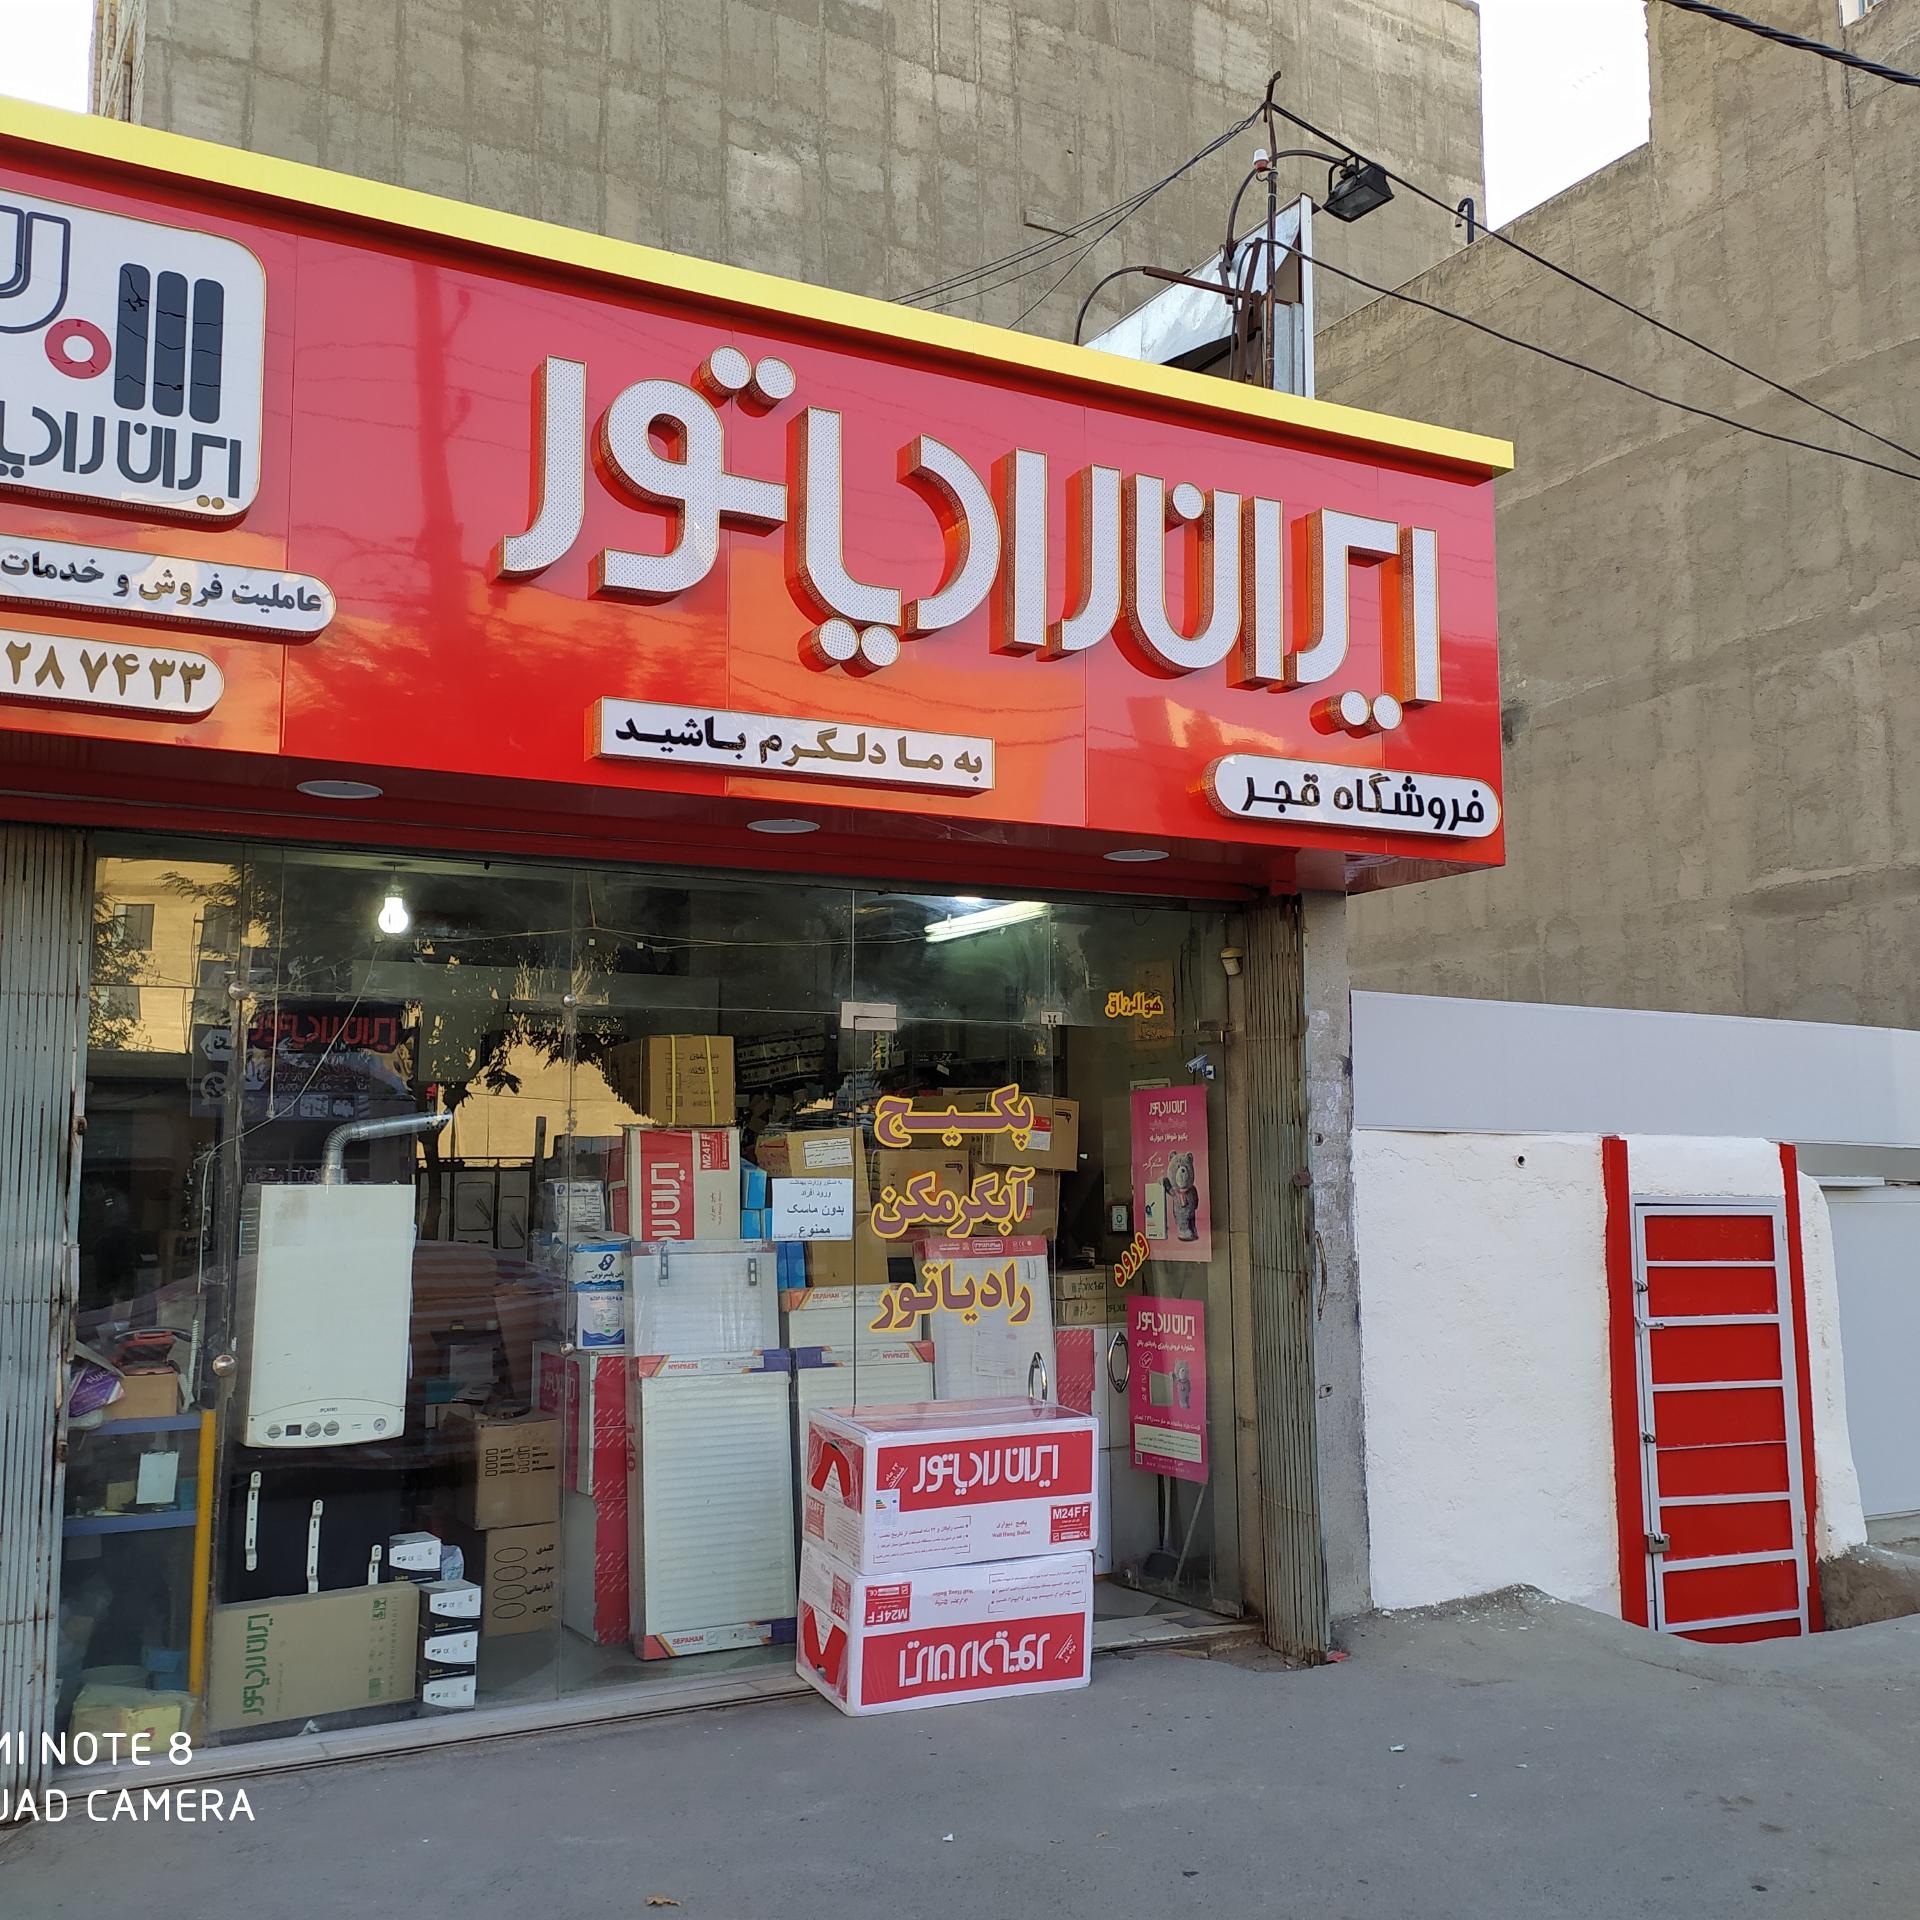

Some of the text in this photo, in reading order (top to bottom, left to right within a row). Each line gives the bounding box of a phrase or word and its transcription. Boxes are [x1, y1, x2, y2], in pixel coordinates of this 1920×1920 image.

[117, 419, 242, 510] ایران
[496, 343, 1439, 731] ایران رادیاتور
[0, 551, 323, 614] عاملیت فروش و خدمات
[615, 715, 983, 783] به ما دلگرم باشید
[1241, 773, 1485, 831] فروشگاه قجر
[875, 1084, 1034, 1151] پکیج
[1149, 1099, 1187, 1117] ایران رادیاتور
[651, 1162, 686, 1216] ایران
[786, 1204, 845, 1216] بدون ماسک
[800, 1188, 831, 1198] ورود افراد
[871, 1167, 1035, 1238] آبگرمکن
[798, 1223, 831, 1239] ممنوع
[1114, 1232, 1149, 1287] ورود
[870, 1259, 1032, 1333] رادیاتور
[1136, 1310, 1195, 1340] ایران رادیاتور
[912, 1444, 1060, 1496] ایران رادیاتور
[1052, 1505, 1090, 1520] M24FF
[242, 1612, 274, 1716] ایران رادیاتور
[672, 1635, 704, 1645] SEPAHAN
[898, 1630, 1051, 1688] ایران رادیاتور
